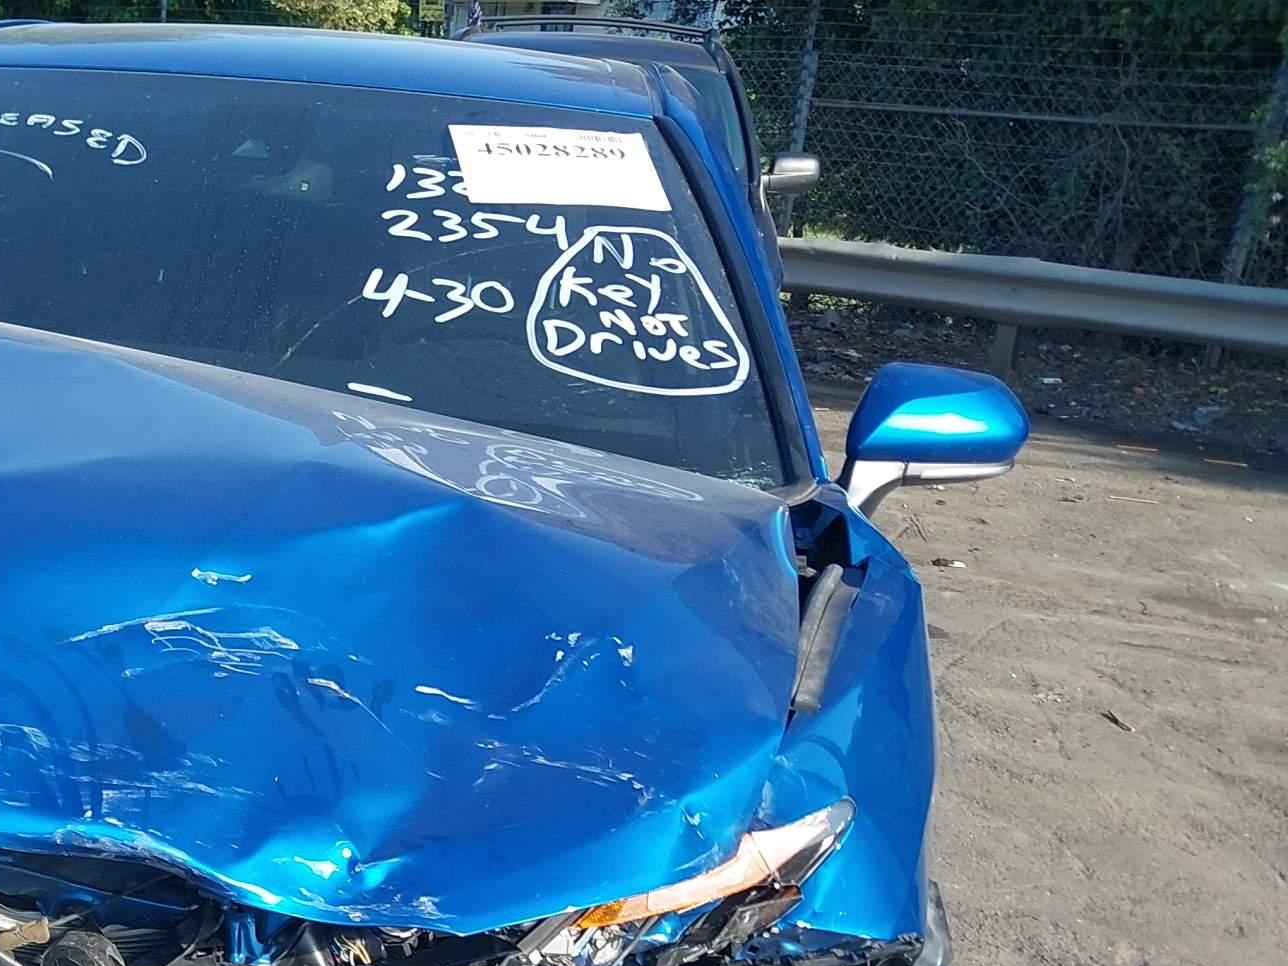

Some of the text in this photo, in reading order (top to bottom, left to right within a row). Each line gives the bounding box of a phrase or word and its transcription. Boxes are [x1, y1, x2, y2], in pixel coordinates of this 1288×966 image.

[477, 142, 626, 160] 45028289
[381, 208, 569, 250] 2354
[362, 267, 515, 323] 4-30
